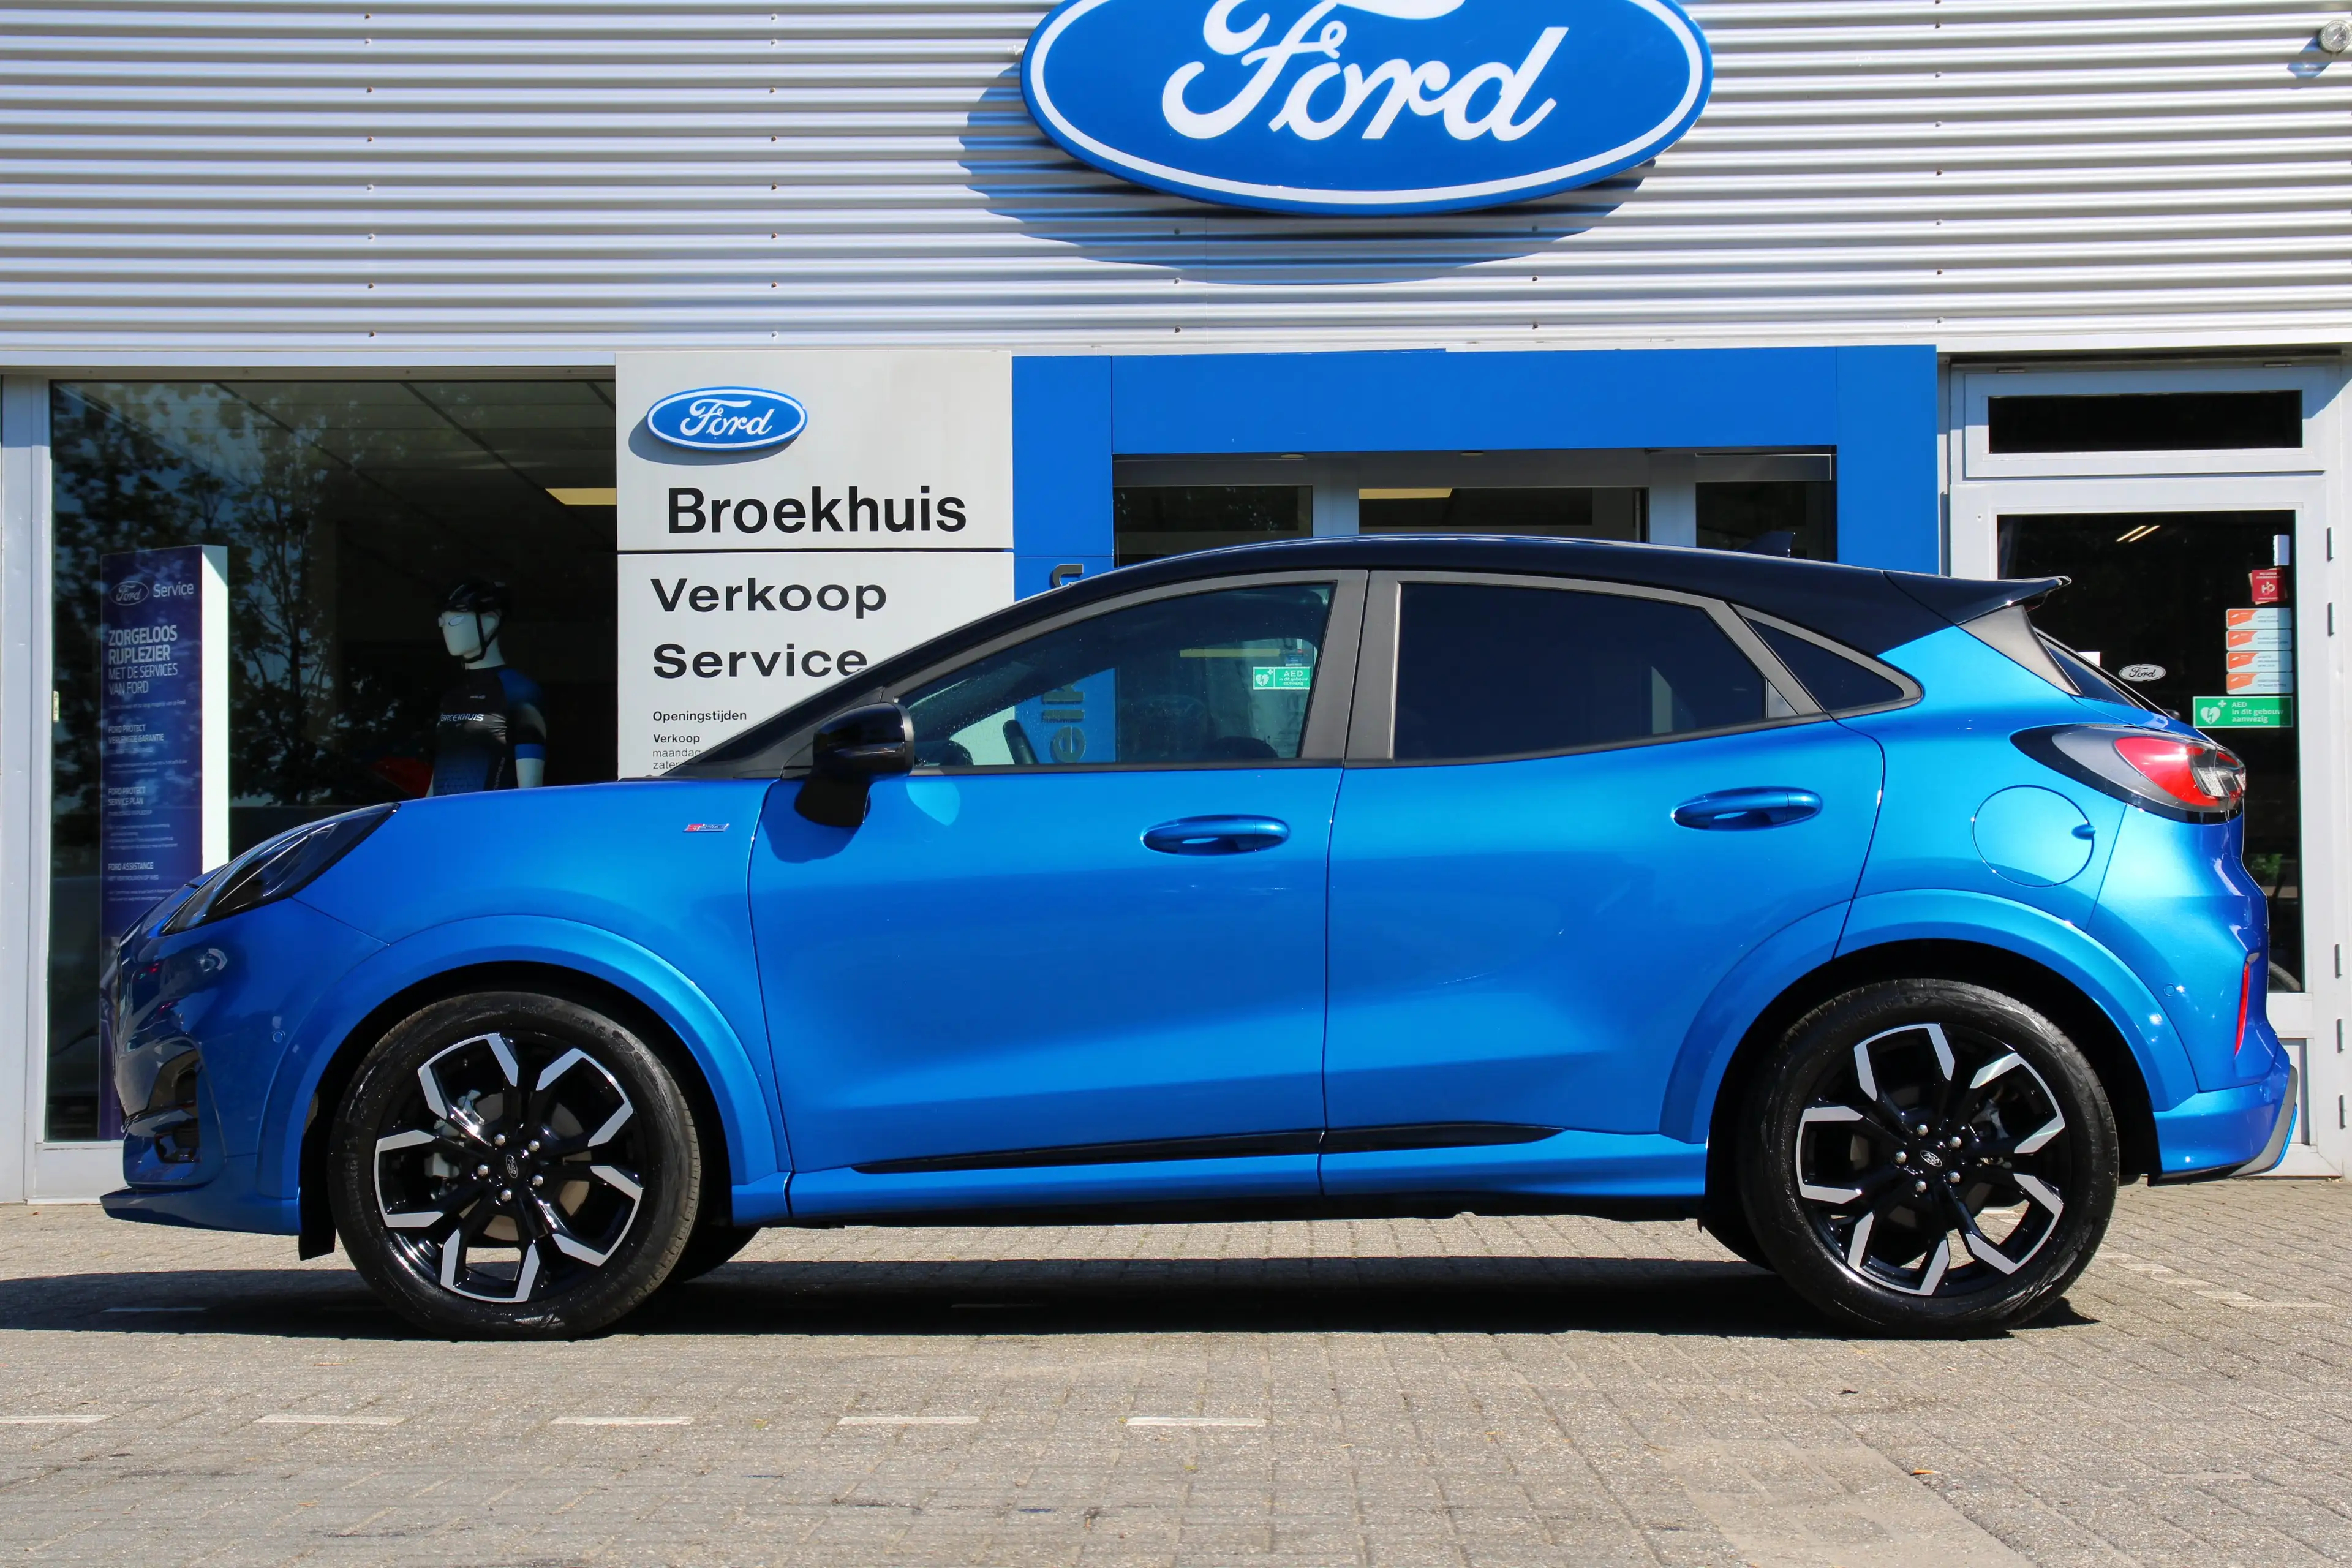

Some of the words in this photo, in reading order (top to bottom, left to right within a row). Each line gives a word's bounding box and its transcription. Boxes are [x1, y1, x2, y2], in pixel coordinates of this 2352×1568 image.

[1161, 0, 1569, 141] Ford
[680, 398, 775, 436] Ford
[668, 485, 967, 534] Broekhuis
[115, 584, 143, 602] Ford
[153, 581, 194, 598] Service
[650, 577, 887, 619] Verkoop
[108, 624, 178, 647] ZORGELOOS
[108, 644, 171, 665] RIJPLEZIER
[653, 643, 869, 679] Service
[108, 666, 127, 680] MET
[127, 666, 138, 679] DE
[139, 662, 178, 679] SERVICES
[2128, 666, 2156, 678] Ford
[108, 681, 125, 696] VAN
[126, 680, 149, 694] FORD
[440, 713, 484, 722] BROEKHUIS
[653, 710, 747, 723] Openingstijden
[123, 724, 146, 733] PROTECT
[138, 733, 164, 742] GARANTIE
[653, 734, 700, 744] Verkoop
[123, 862, 154, 870] ASSISTANCE
